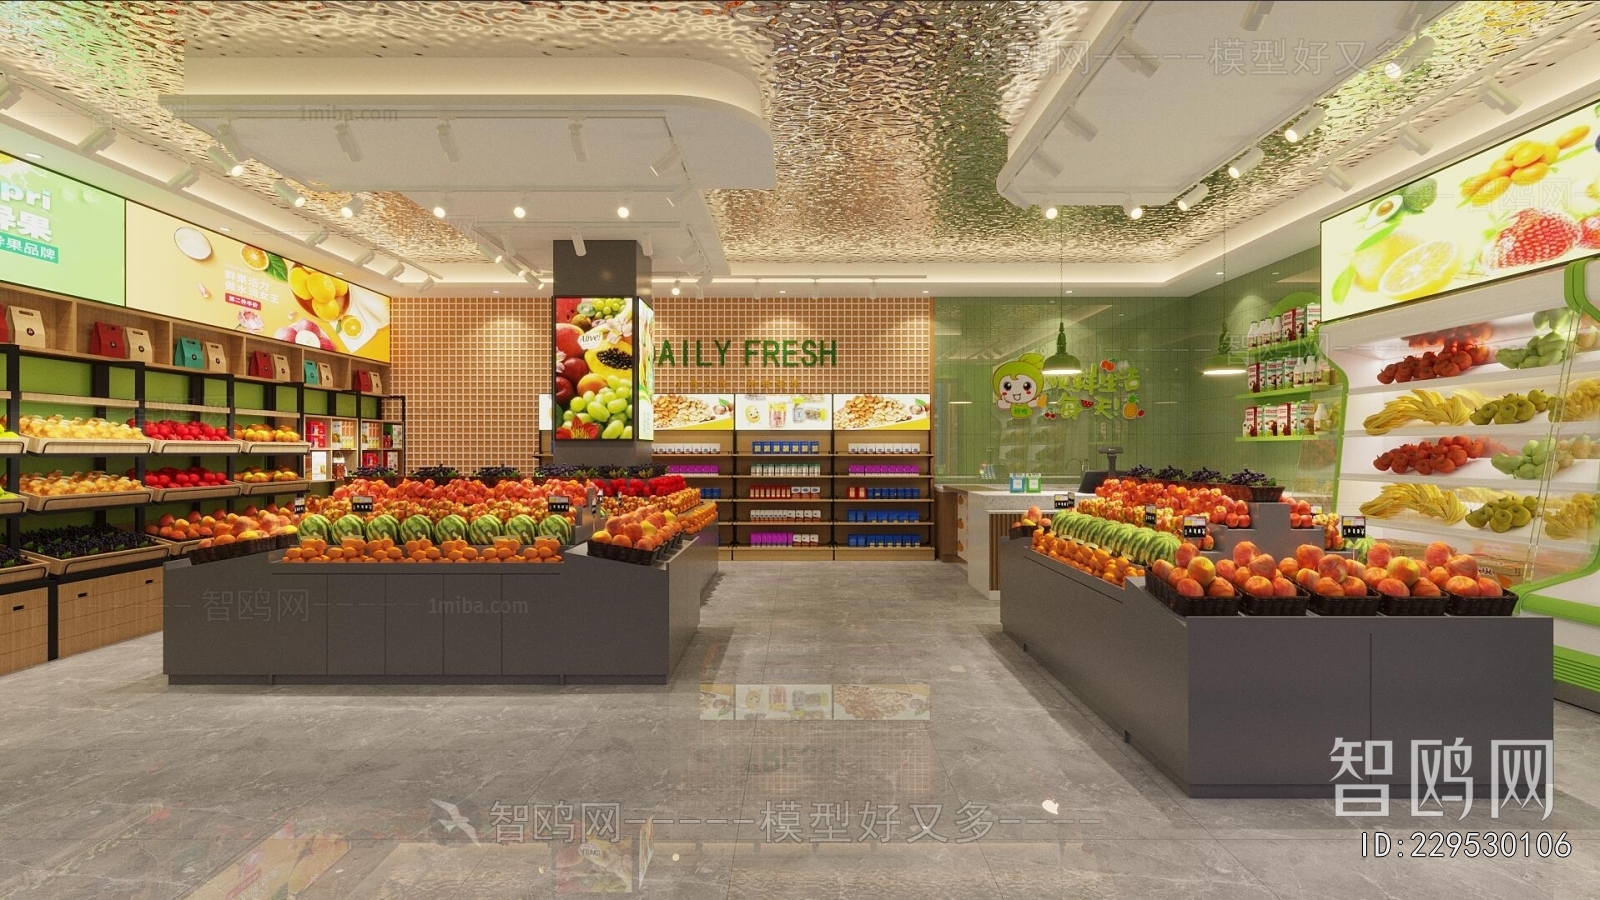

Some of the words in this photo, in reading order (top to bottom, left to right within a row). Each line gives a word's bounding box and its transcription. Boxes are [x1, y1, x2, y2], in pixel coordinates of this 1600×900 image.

[0, 236, 56, 261] 果品牌
[579, 333, 601, 343] Alive!
[653, 339, 732, 367] AILY
[744, 339, 837, 368] FRESH
